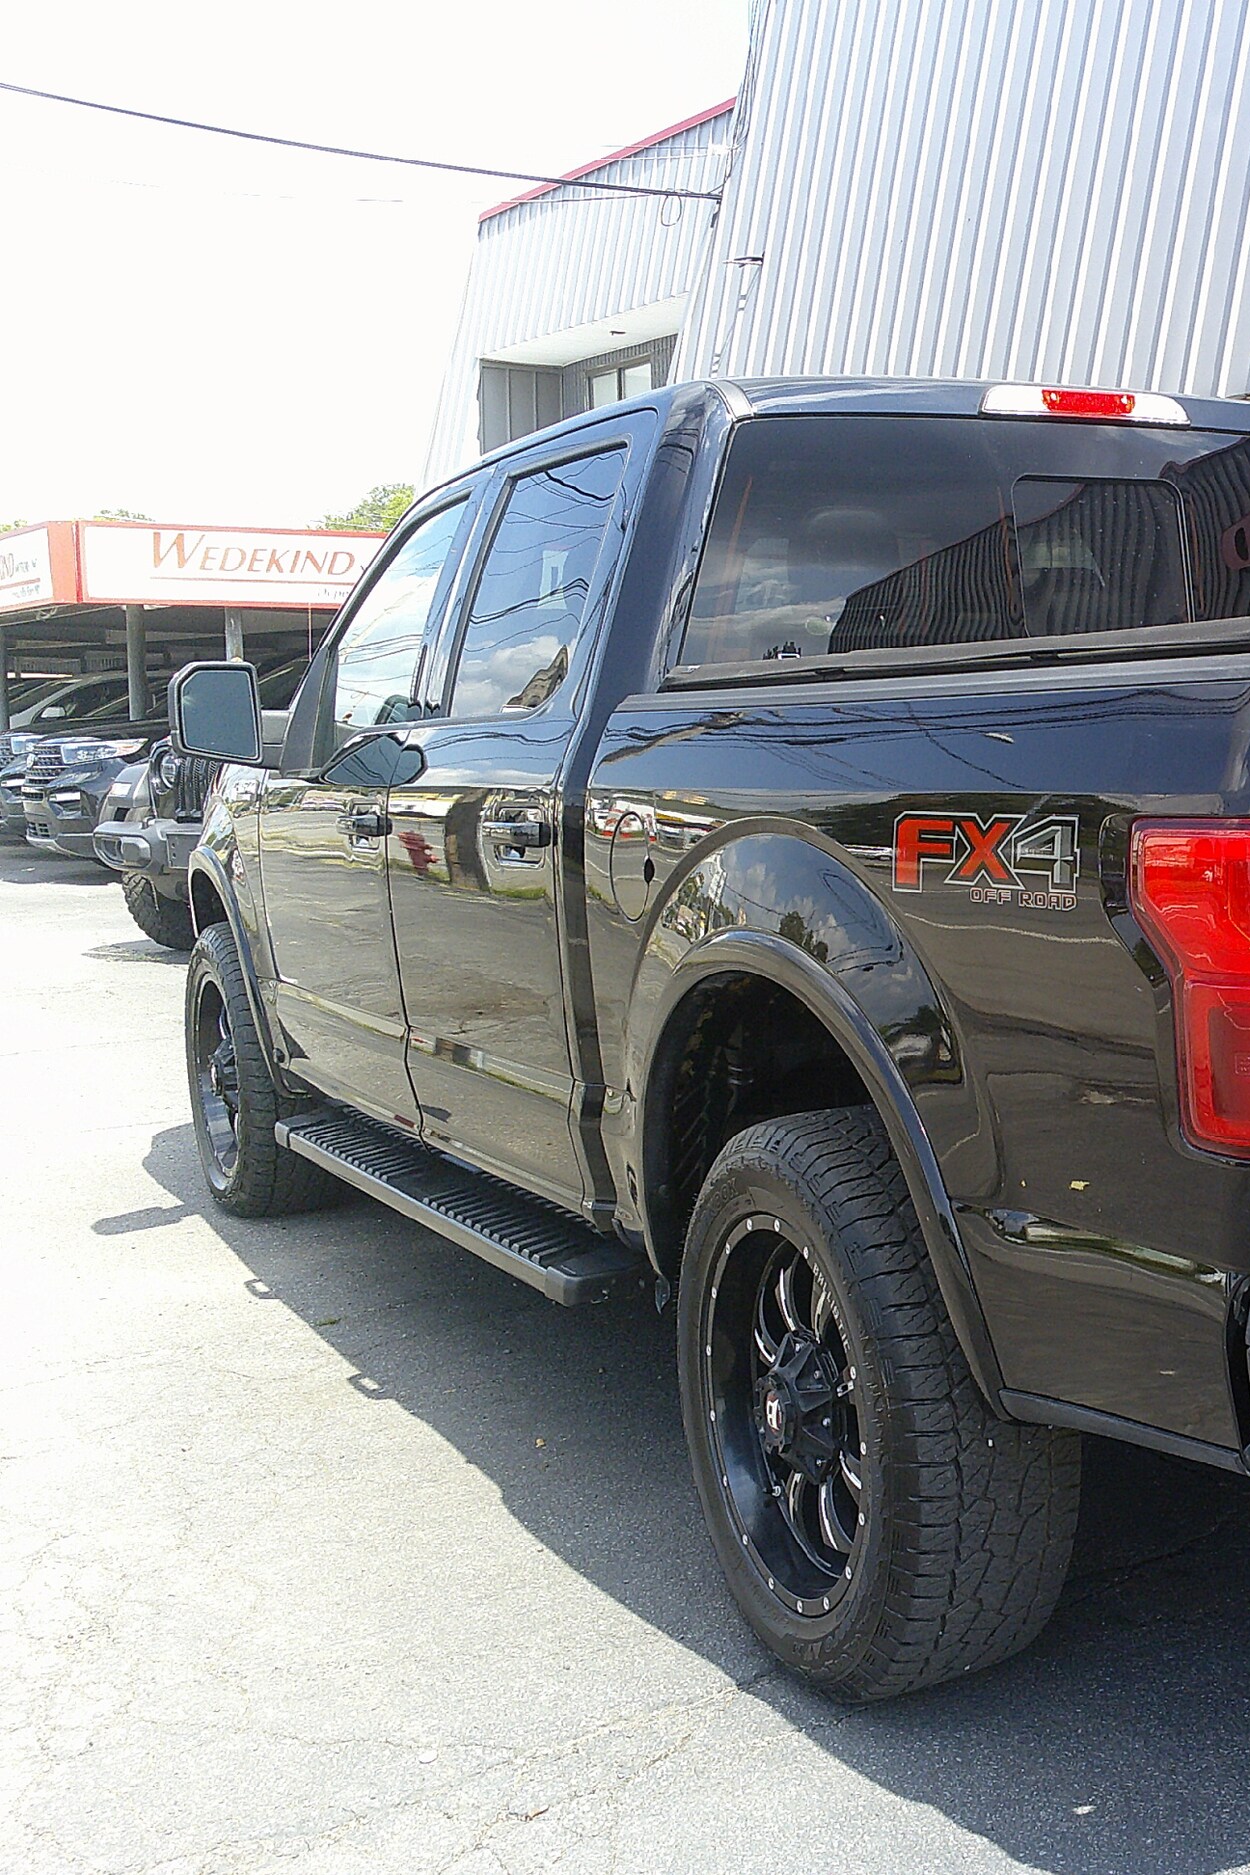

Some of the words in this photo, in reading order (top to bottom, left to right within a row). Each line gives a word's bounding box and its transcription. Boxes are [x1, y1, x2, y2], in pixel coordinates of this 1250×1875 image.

[153, 531, 355, 575] WEDEKIND
[892, 811, 1080, 893] FX4
[969, 887, 1011, 905] OFF
[1018, 891, 1077, 912] ROAD
